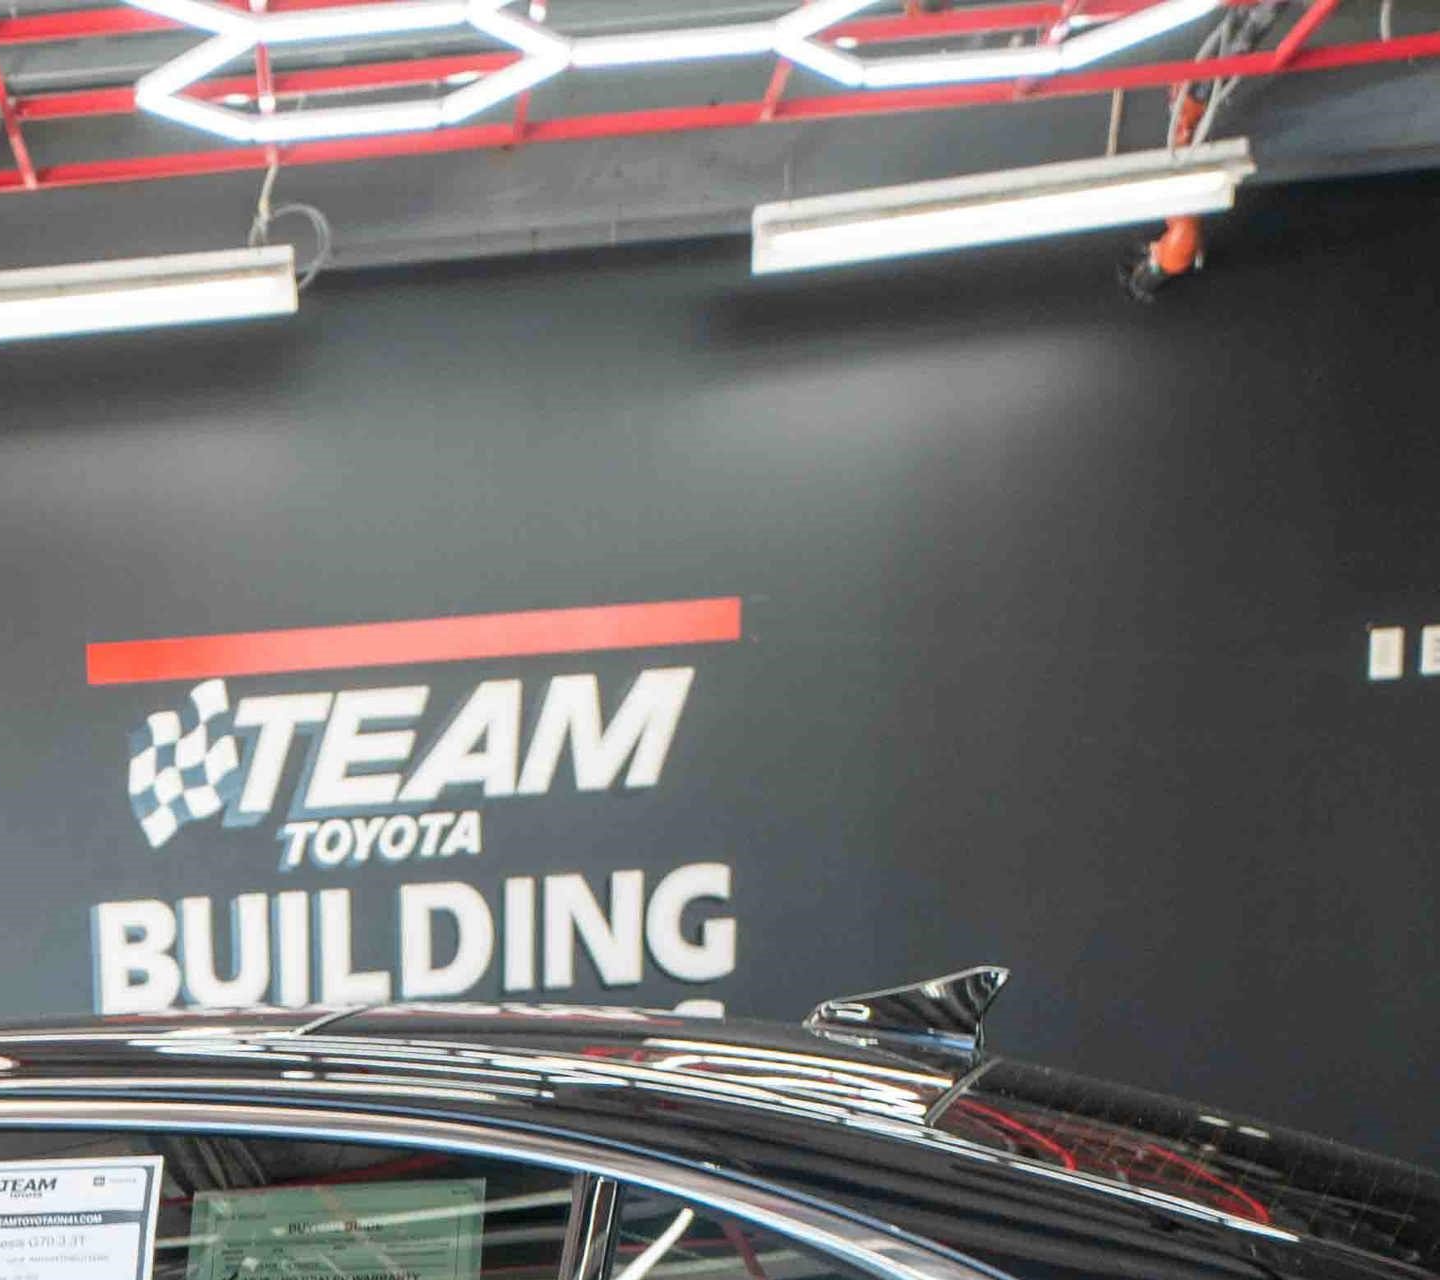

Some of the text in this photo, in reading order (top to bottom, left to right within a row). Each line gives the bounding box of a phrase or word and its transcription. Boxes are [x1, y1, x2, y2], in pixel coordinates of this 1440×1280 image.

[227, 667, 695, 816] TEAM
[280, 812, 481, 868] TOYOTA
[95, 863, 736, 1014] BUILDING
